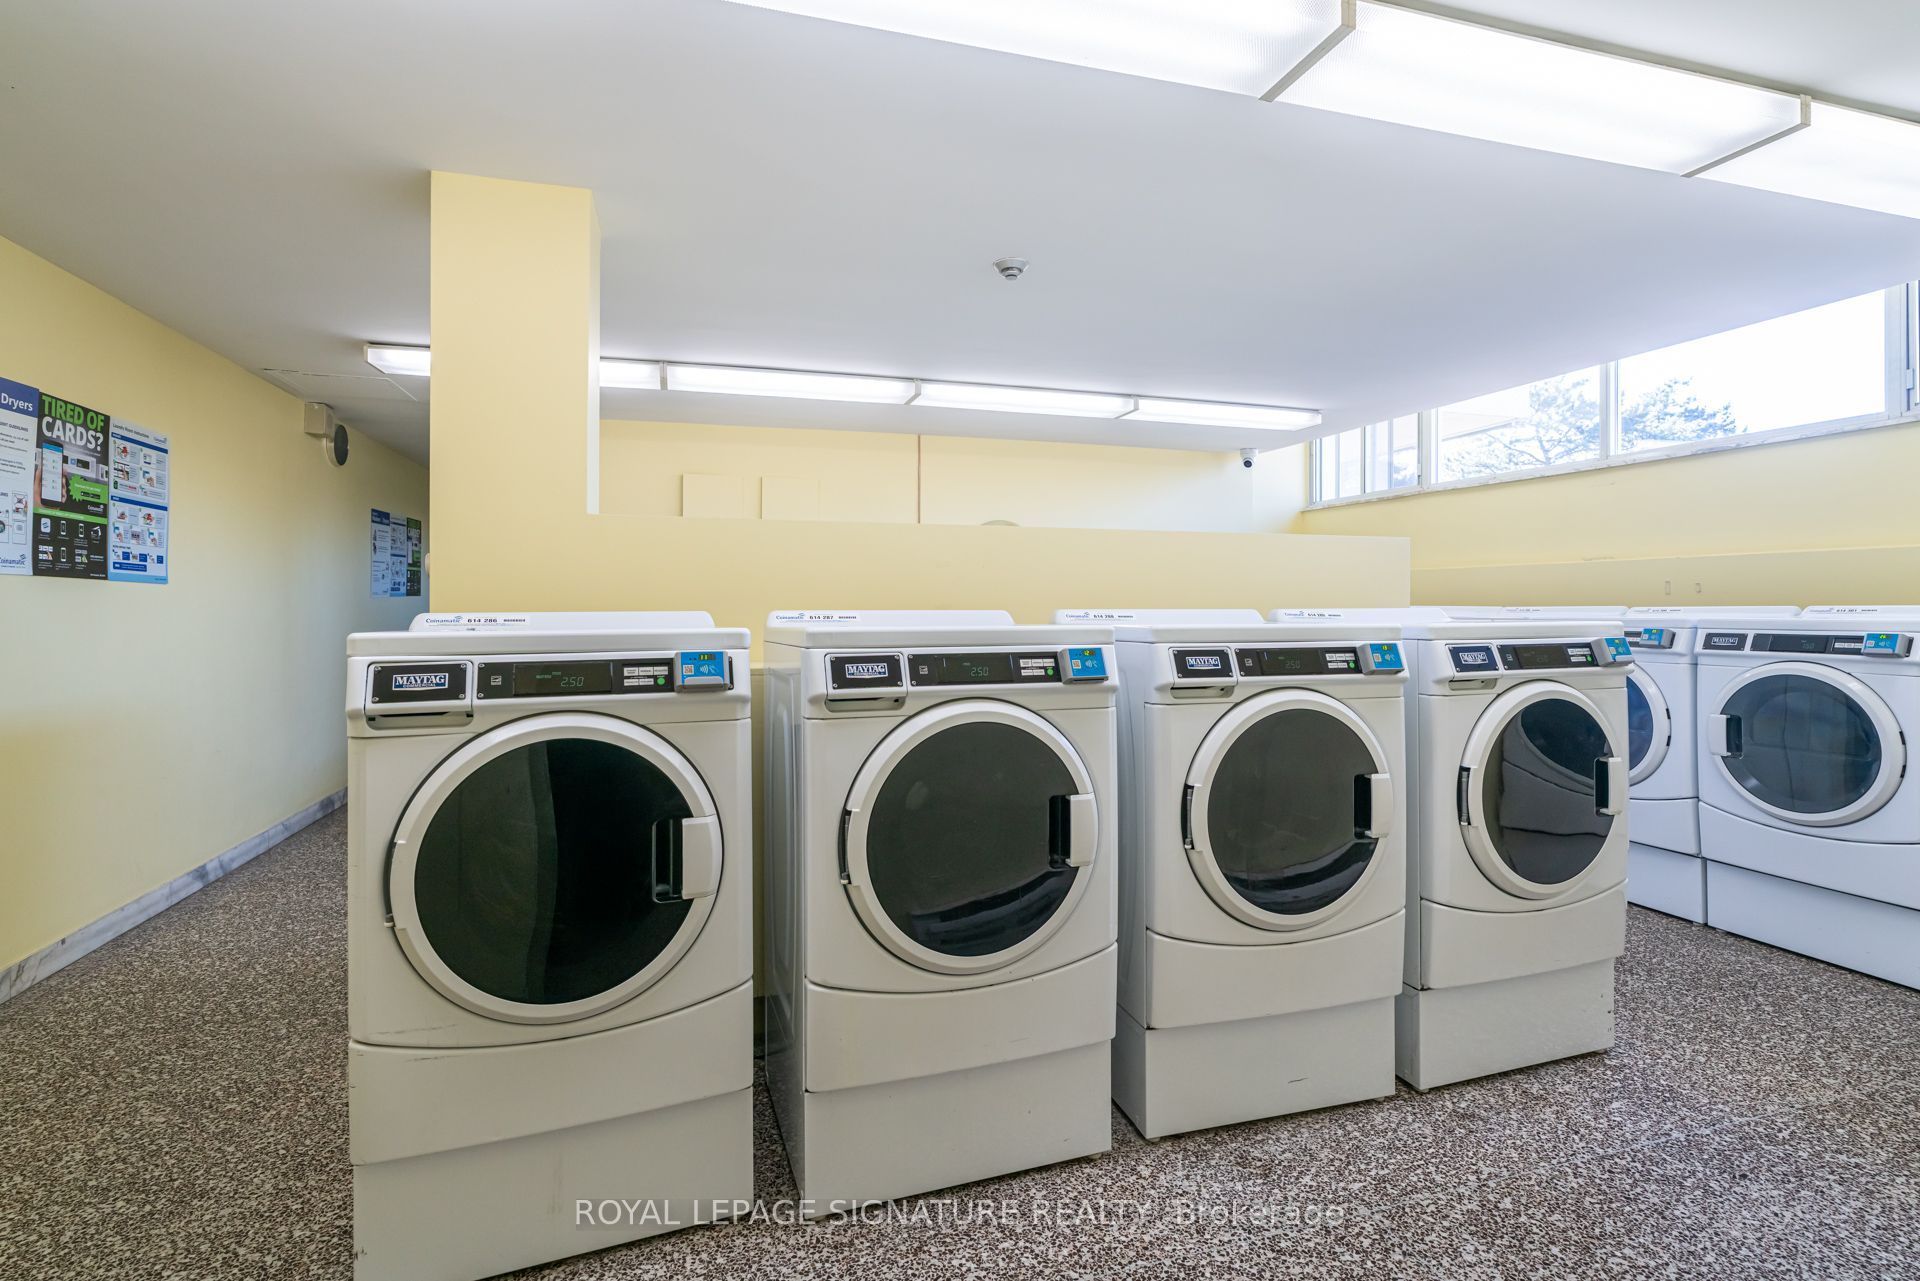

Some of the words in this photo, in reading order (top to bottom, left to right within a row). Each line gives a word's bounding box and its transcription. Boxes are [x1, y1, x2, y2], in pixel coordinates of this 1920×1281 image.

[1, 393, 33, 411] Dryers
[42, 395, 84, 425] TIRED
[87, 411, 104, 431] OF
[42, 416, 104, 451] CARDS?
[848, 664, 885, 673] MAYTAG
[970, 667, 989, 677] 2.50
[396, 675, 445, 685] MAYTAG
[561, 676, 584, 687] 2.50
